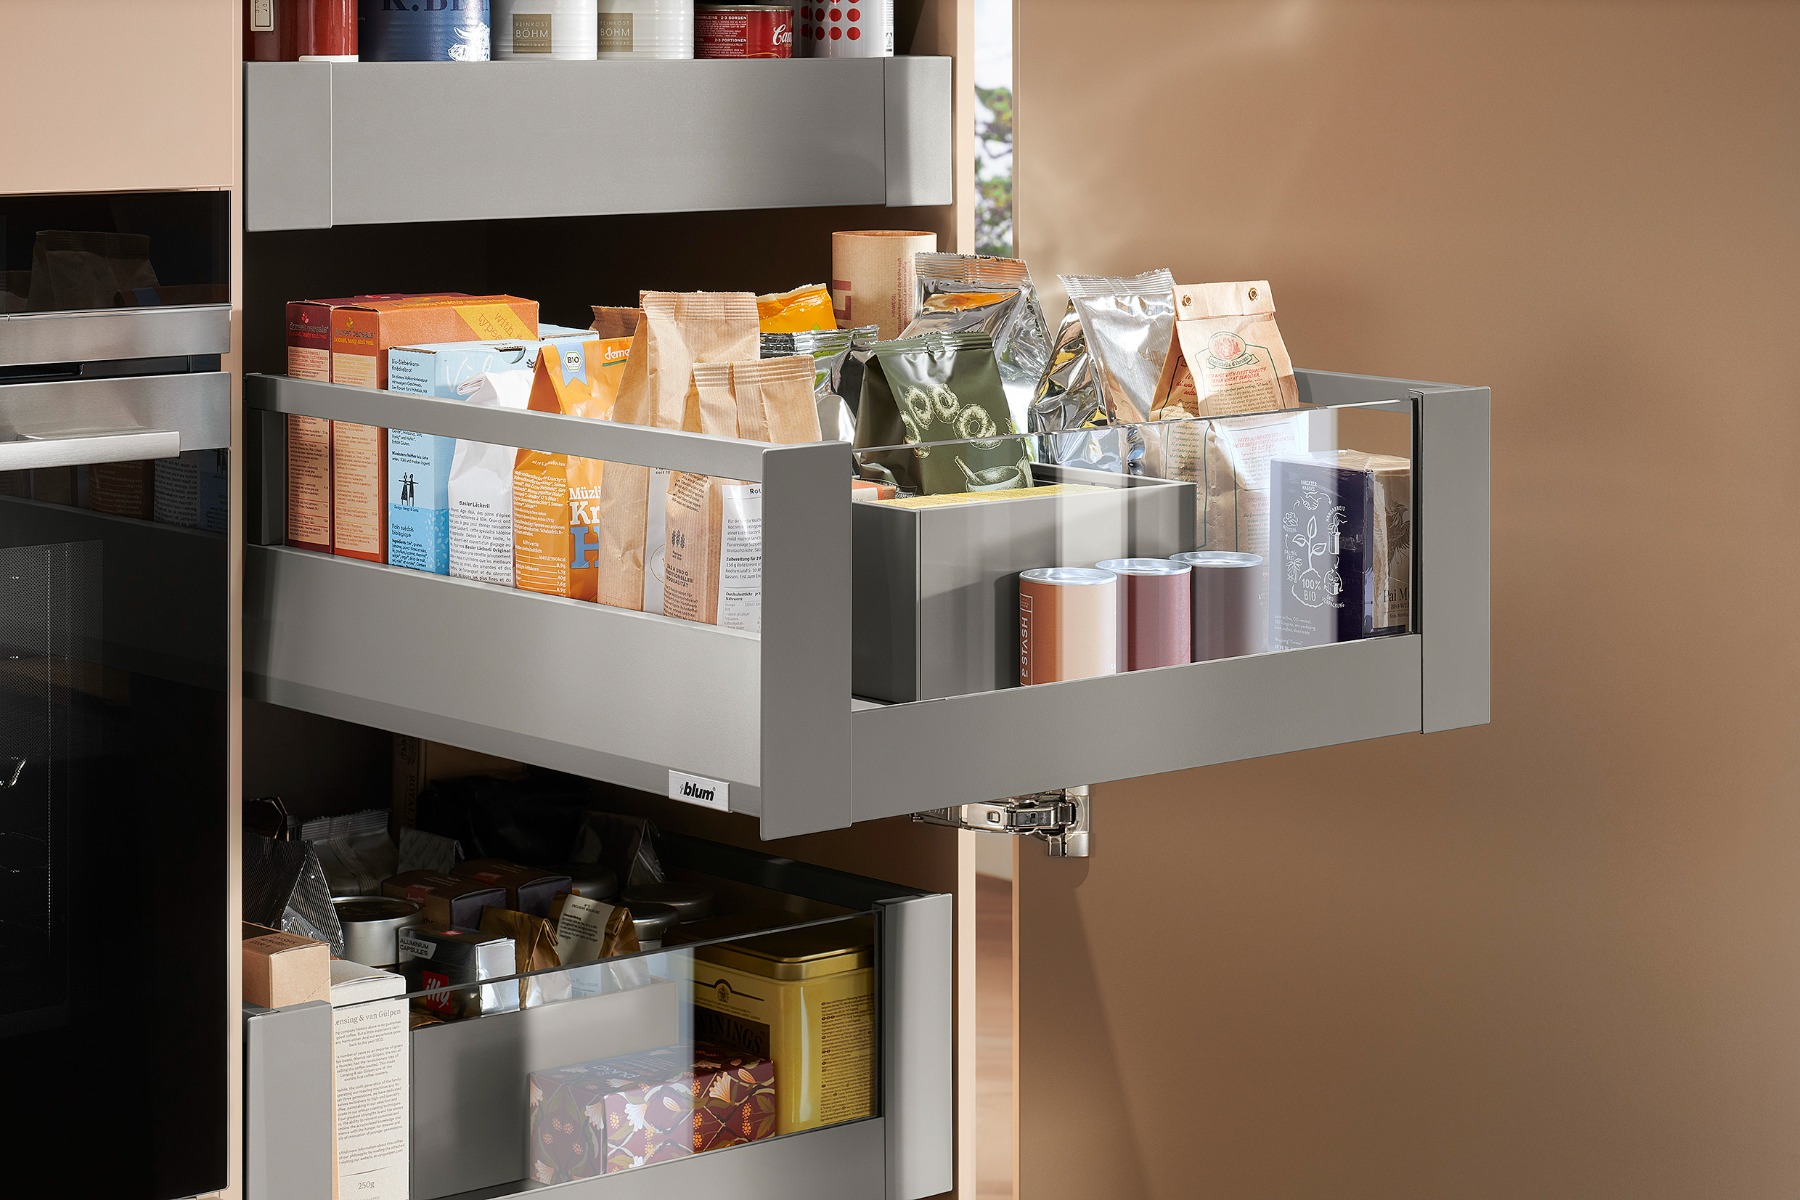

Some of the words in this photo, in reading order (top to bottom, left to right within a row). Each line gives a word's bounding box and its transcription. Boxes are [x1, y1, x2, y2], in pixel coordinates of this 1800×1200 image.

[515, 28, 548, 38] BÖHM
[600, 27, 630, 36] BÖHM
[567, 356, 580, 364] BIO
[569, 486, 601, 499] Müzli
[1302, 579, 1321, 590] 100%
[1304, 590, 1316, 601] BIO
[1384, 590, 1396, 602] Pai
[683, 782, 714, 801] blum
[400, 938, 429, 950] ALUMINIUM
[400, 944, 429, 956] CAPSULES
[426, 978, 450, 1008] illy
[335, 1015, 359, 1025] ensing
[379, 1009, 401, 1018] Gülpen
